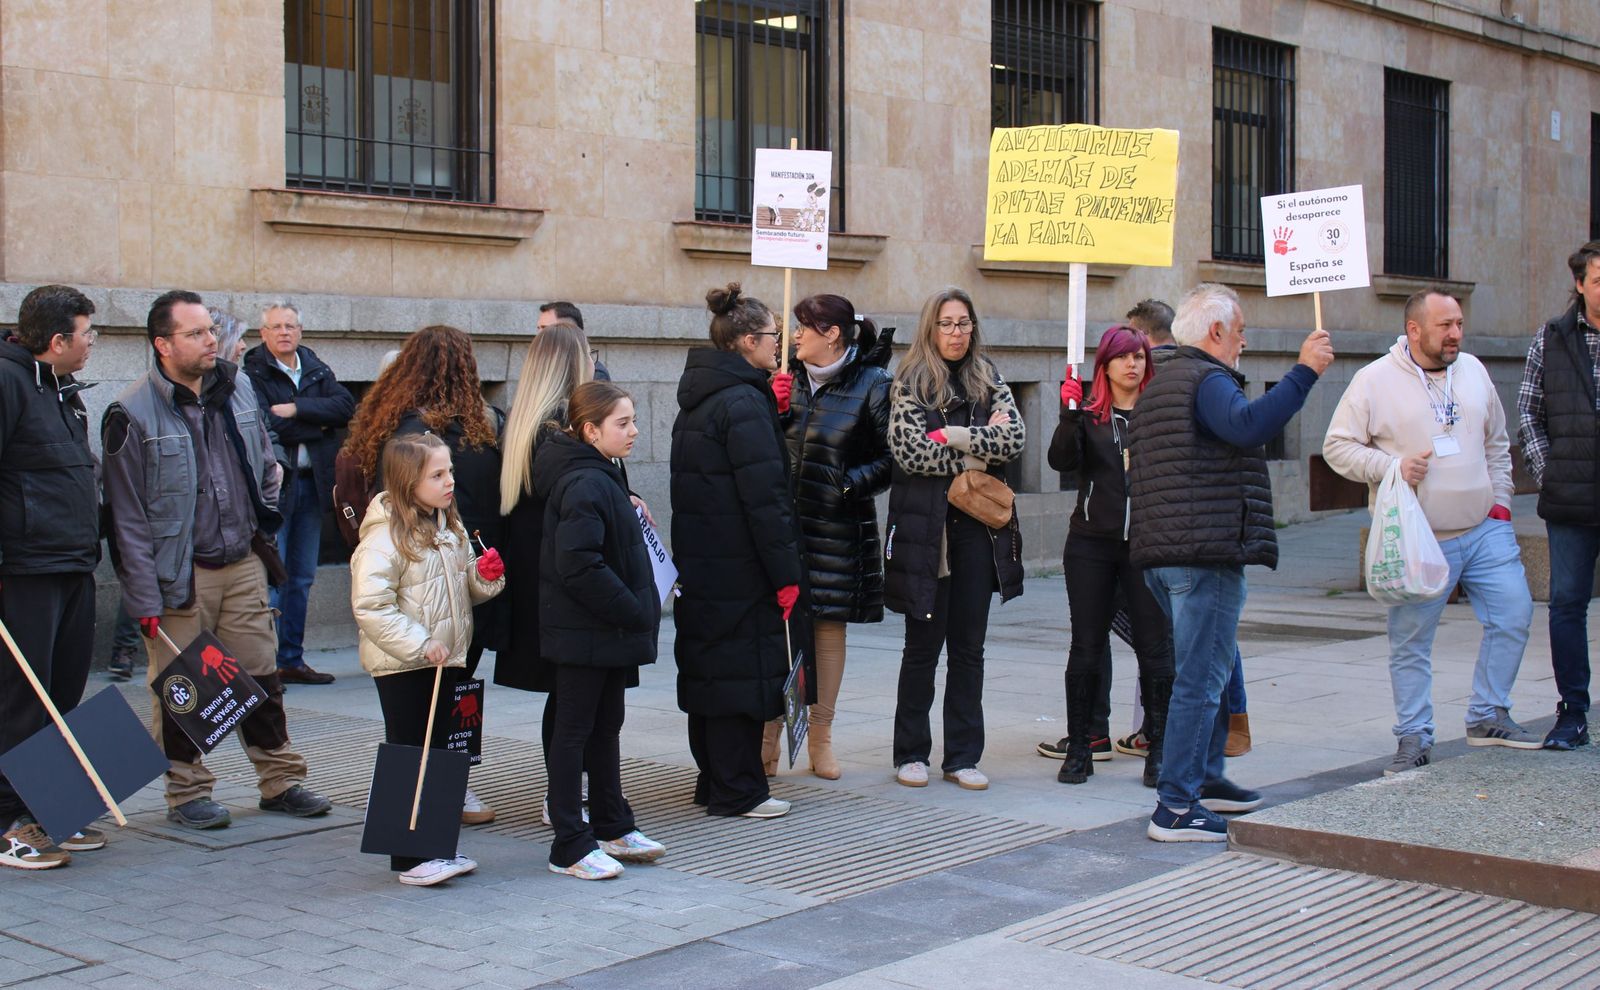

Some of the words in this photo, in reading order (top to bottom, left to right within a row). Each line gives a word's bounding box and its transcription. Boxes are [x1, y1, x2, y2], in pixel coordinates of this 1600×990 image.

[771, 170, 805, 180] MANIFESTACIÓN
[805, 172, 815, 180] 30N
[996, 155, 1094, 189] ADEMÁS
[1100, 164, 1138, 189] DE
[993, 189, 1066, 215] PUTAS
[1075, 193, 1174, 224] PONEMOS
[1277, 200, 1286, 209] Si
[1288, 198, 1297, 208] el
[1298, 194, 1348, 207] autónomo
[1285, 209, 1341, 222] desaparece
[755, 229, 788, 237] Sembrando
[991, 222, 1019, 247] LA
[1028, 220, 1095, 247] CAMA
[1326, 228, 1340, 240] 30
[1289, 259, 1329, 272] España
[1331, 259, 1343, 267] se
[1289, 273, 1346, 286] desvanece
[638, 512, 666, 564] TRABAJO
[170, 684, 179, 693] N
[221, 687, 233, 699] SE
[173, 687, 190, 705] 30
[244, 694, 259, 709] SIN
[199, 695, 224, 720] HUNDE
[210, 699, 238, 724] ESPAÑA
[205, 706, 246, 746] AUTÓNOMOS
[454, 731, 473, 740] SOLO
[456, 740, 467, 748] SIN
